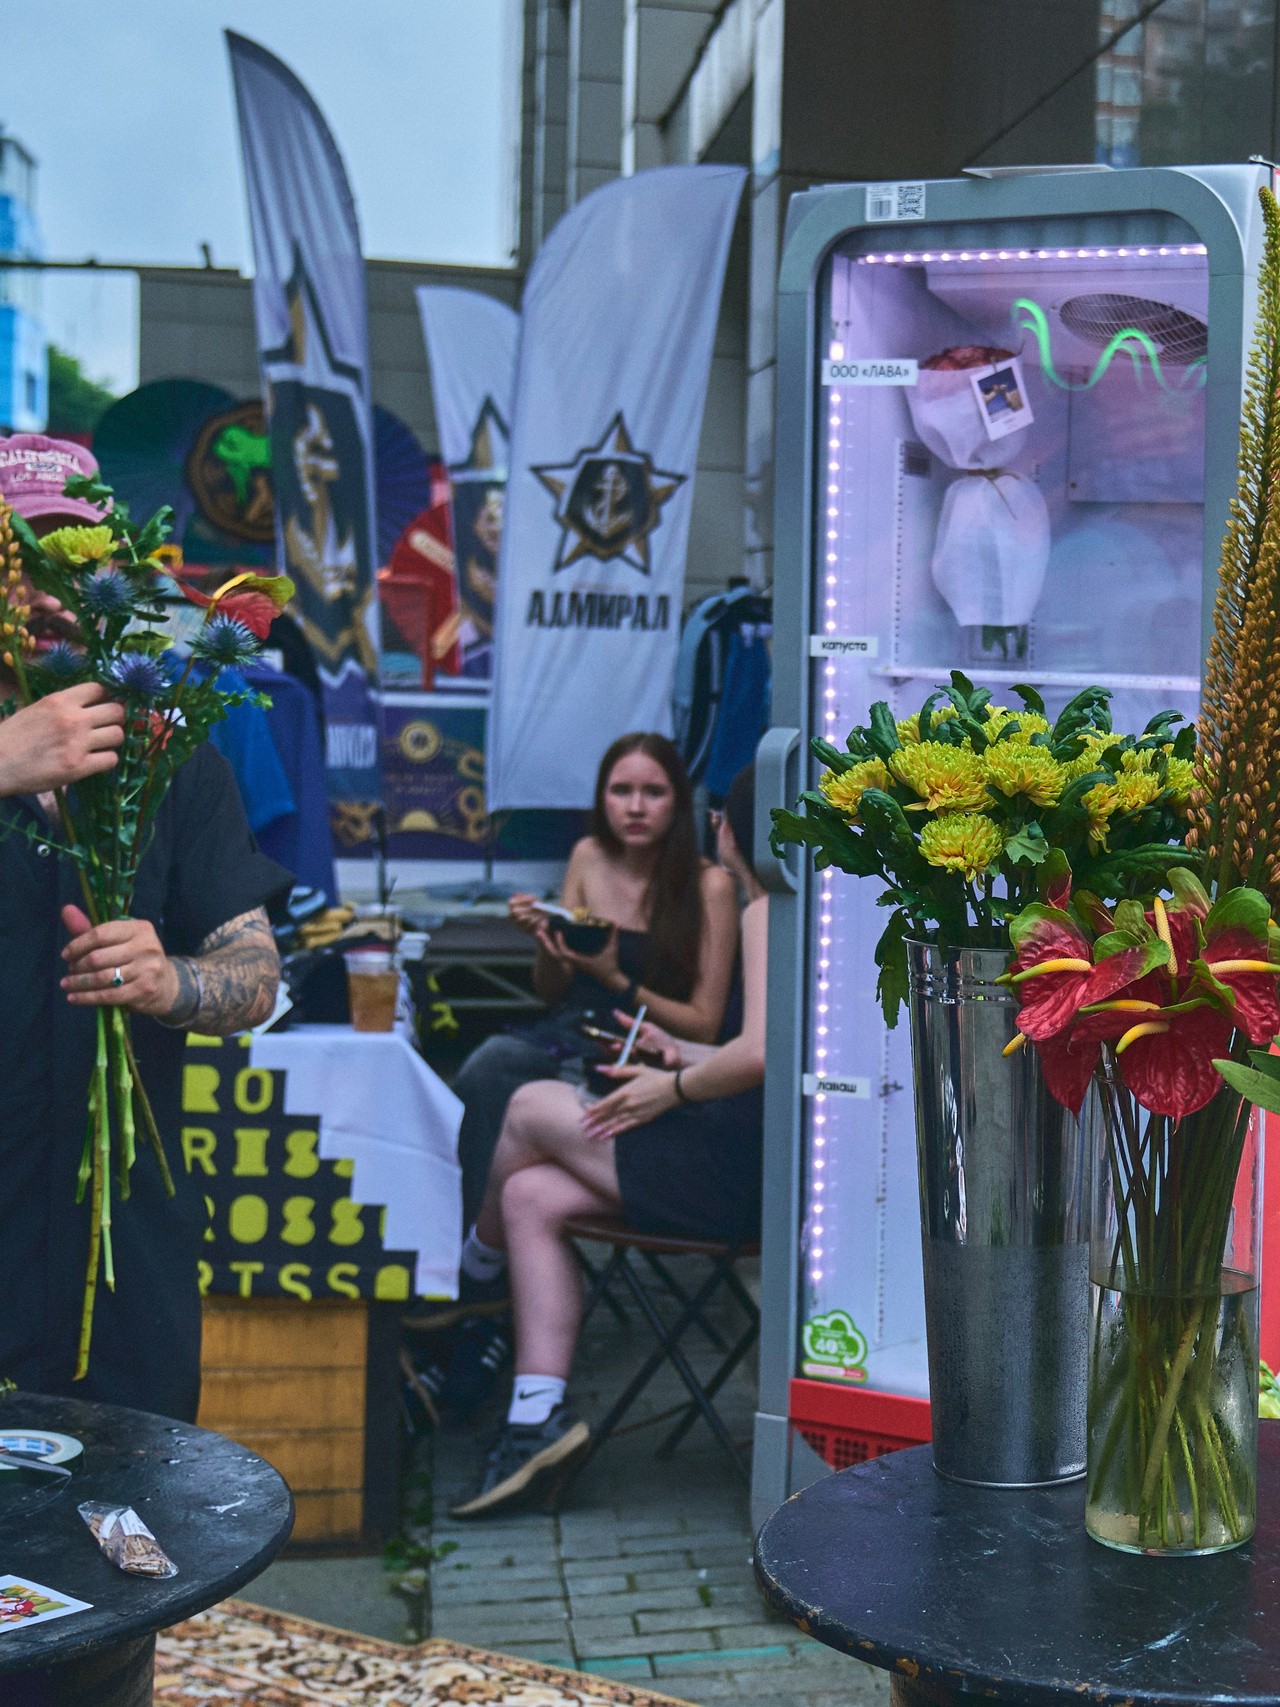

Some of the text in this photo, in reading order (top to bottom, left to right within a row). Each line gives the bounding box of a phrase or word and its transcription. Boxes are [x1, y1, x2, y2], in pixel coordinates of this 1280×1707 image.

[831, 365, 910, 379] ООО «ЛАВА»
[527, 590, 669, 631] АДМИРАЛ
[822, 641, 868, 654] капуста
[816, 1081, 857, 1093] лаваш
